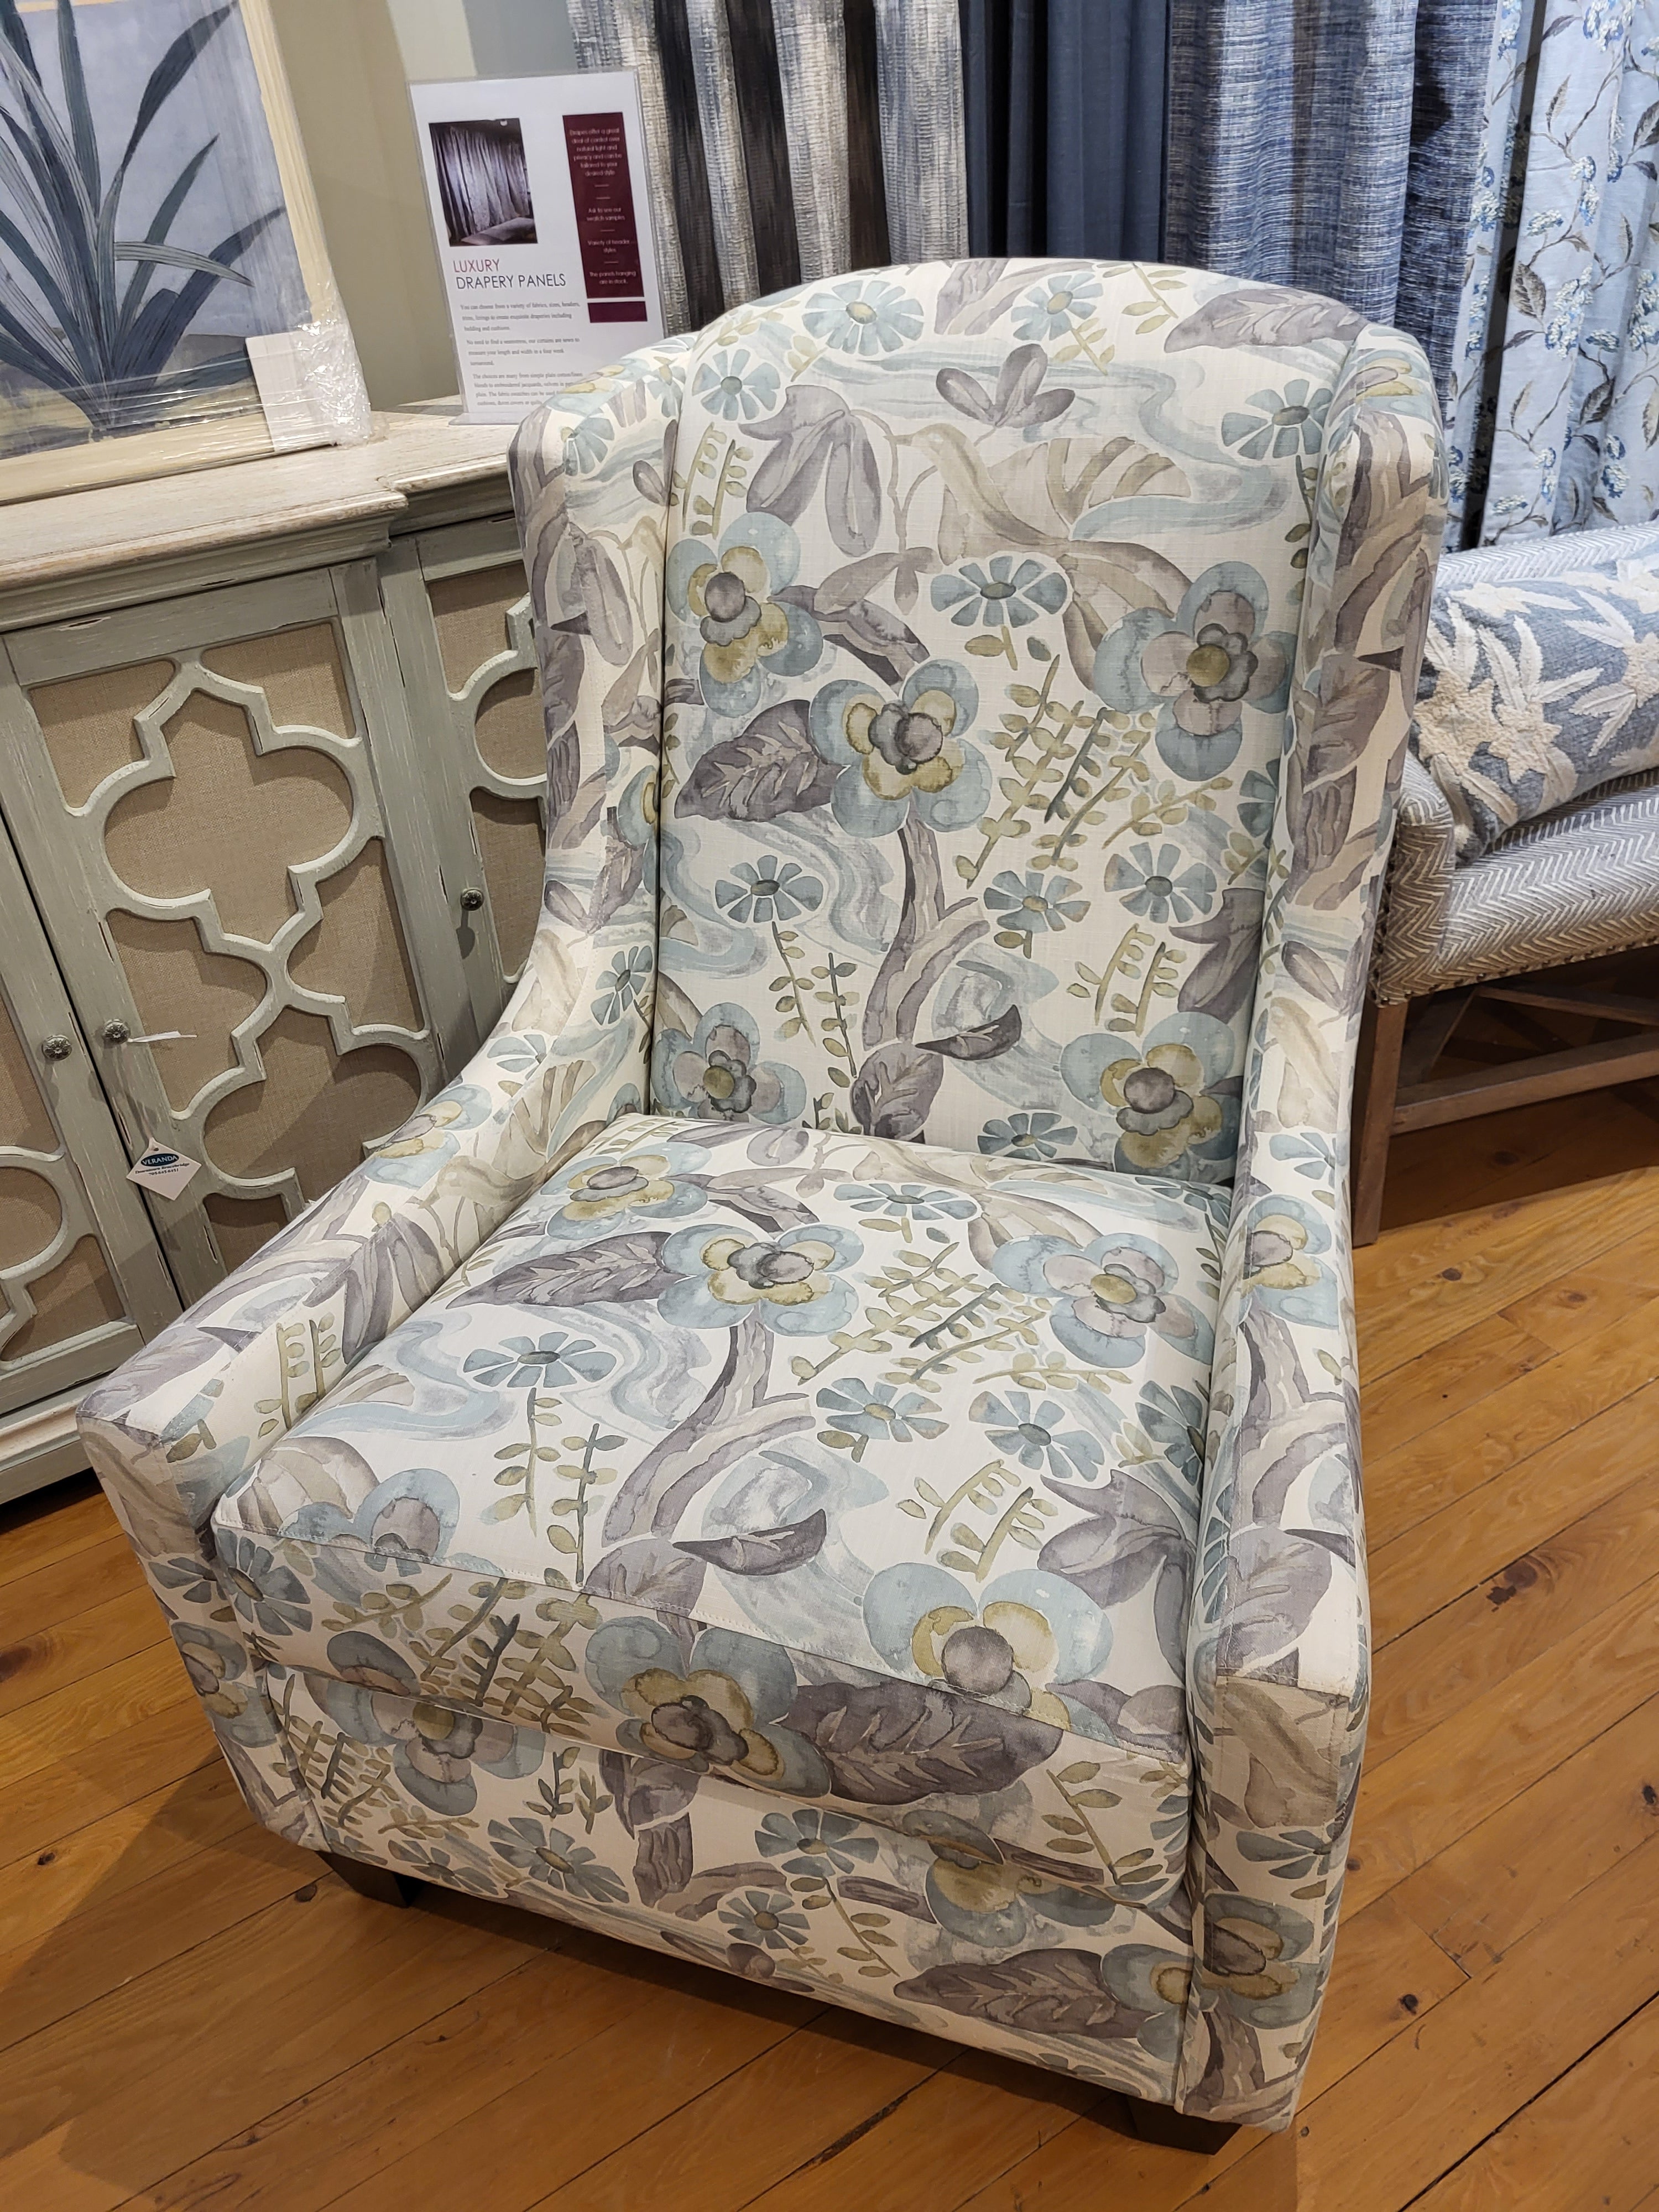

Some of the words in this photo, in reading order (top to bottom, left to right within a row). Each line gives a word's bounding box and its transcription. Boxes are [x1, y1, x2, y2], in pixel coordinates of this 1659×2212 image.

[453, 259, 499, 273] LUXURY
[456, 275, 513, 289] DRAPERY
[518, 273, 566, 288] PANELS
[142, 1155, 178, 1165] VERANDA
